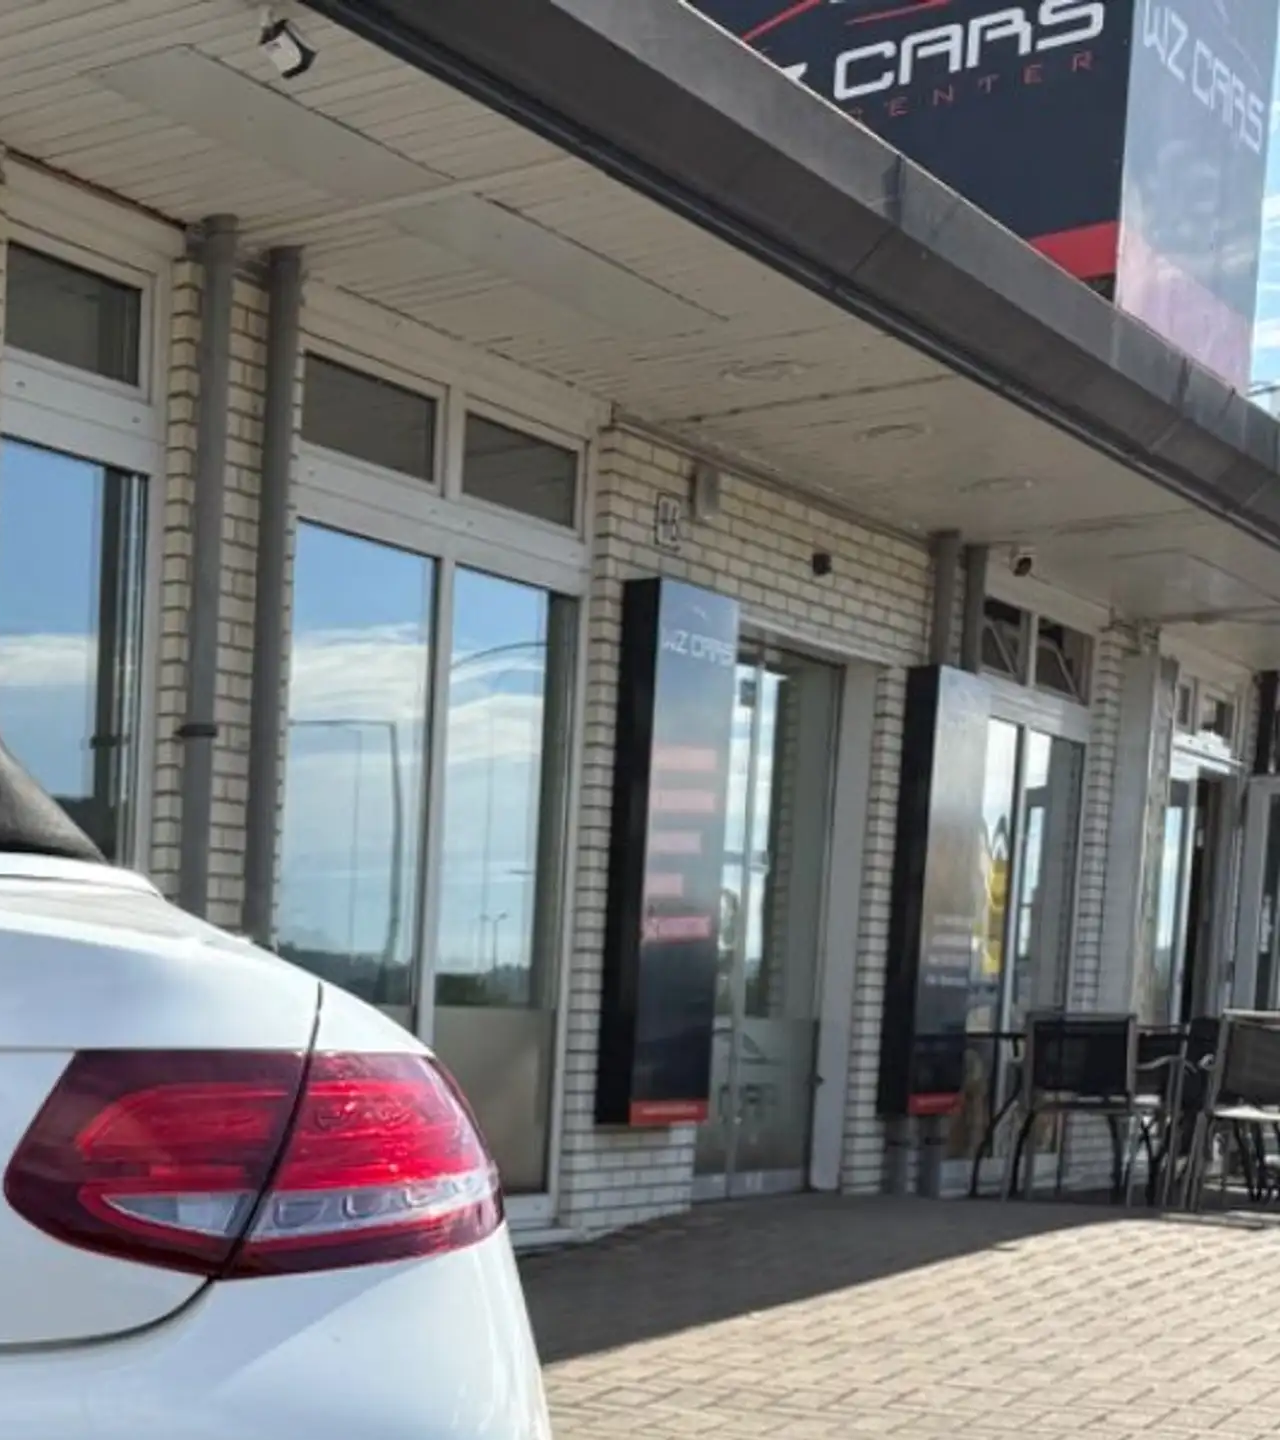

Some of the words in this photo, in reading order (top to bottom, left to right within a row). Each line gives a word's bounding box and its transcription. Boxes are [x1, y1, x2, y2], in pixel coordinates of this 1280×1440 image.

[833, 0, 1105, 100] CARS
[1142, 0, 1188, 83] WZ
[1191, 39, 1265, 156] CARS
